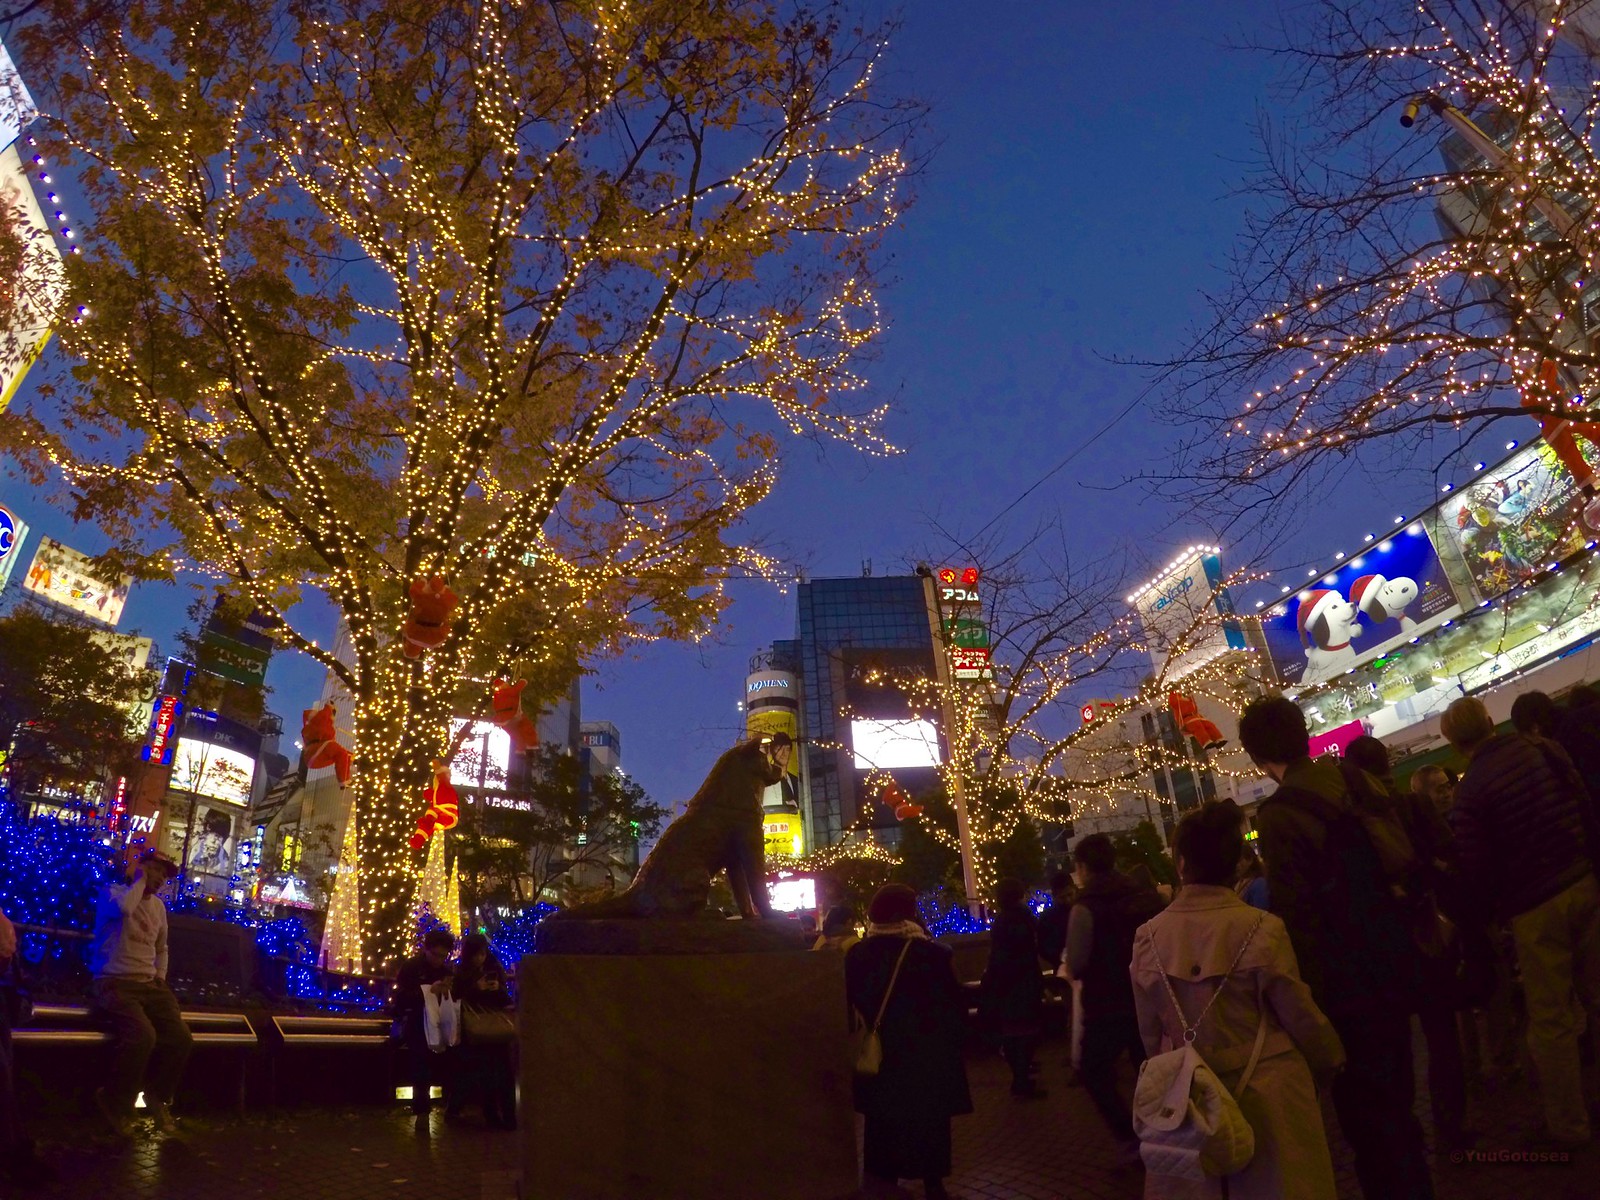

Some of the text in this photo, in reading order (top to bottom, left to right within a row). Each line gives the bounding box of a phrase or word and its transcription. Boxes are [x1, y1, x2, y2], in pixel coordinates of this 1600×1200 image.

[1559, 494, 1572, 506] ON
[942, 588, 979, 601] アコム
[214, 731, 236, 745] DHC
